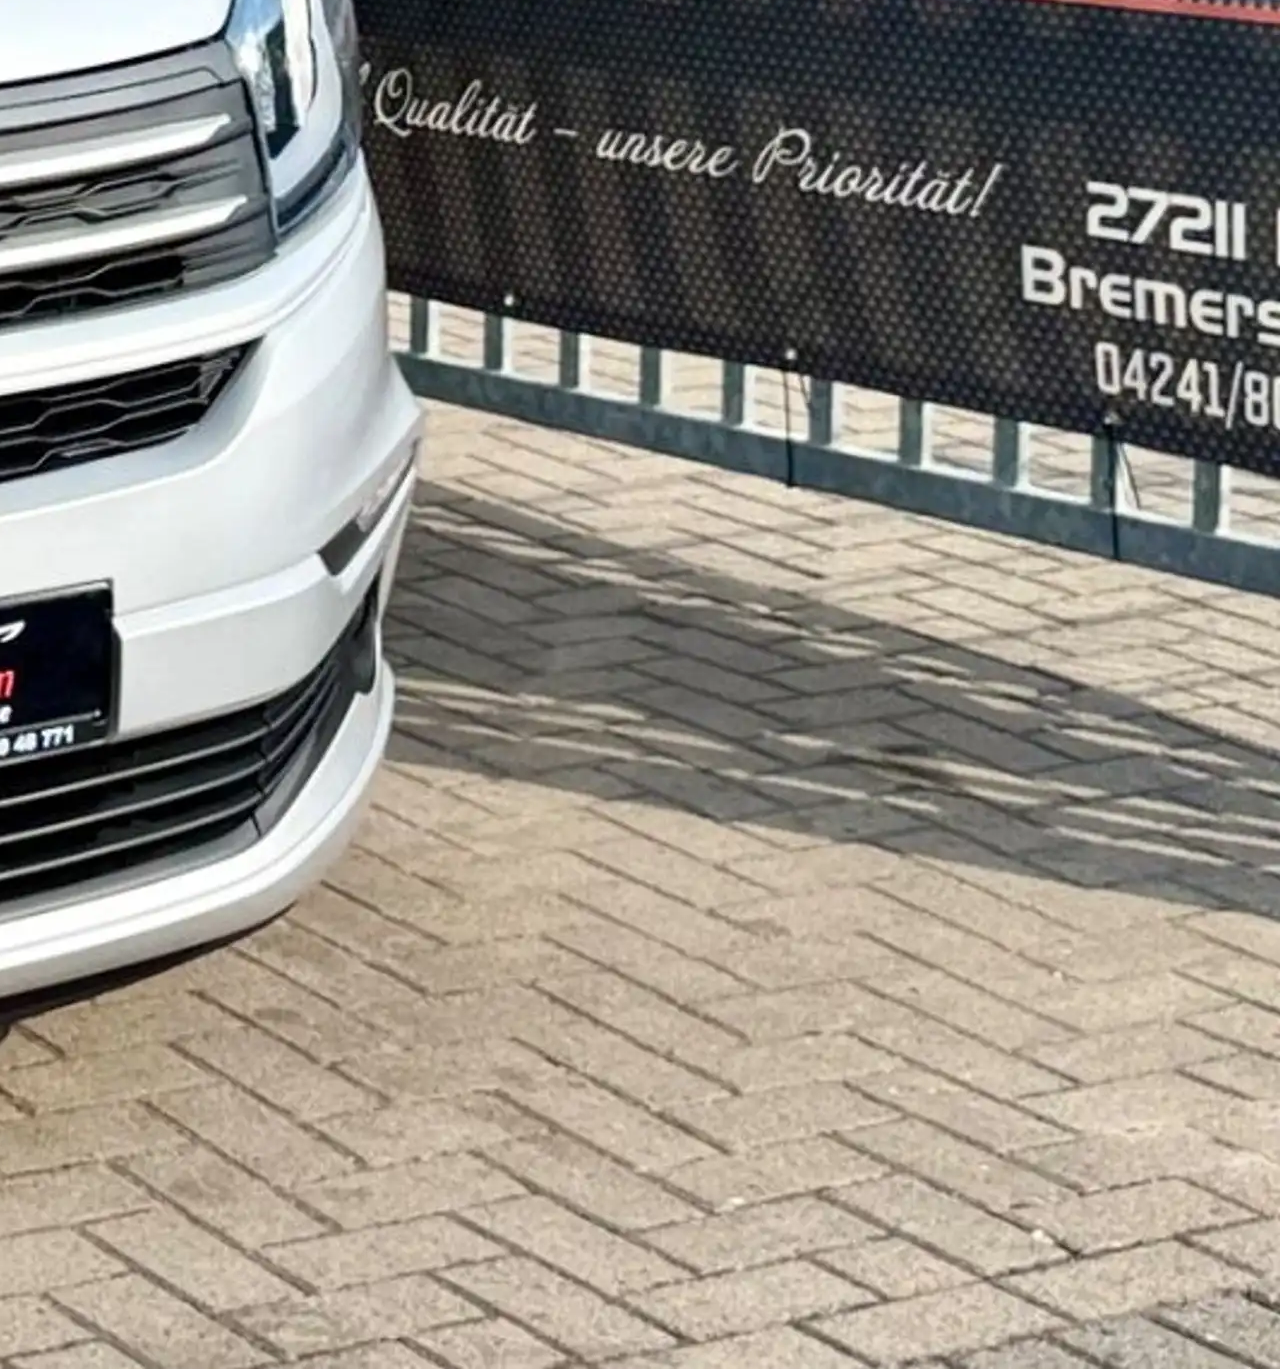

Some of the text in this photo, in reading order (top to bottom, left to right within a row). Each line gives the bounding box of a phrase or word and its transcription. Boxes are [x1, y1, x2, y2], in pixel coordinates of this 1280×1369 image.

[596, 132, 739, 178] unsere
[752, 126, 1003, 219] Priorität!
[1086, 180, 1246, 261] 27211
